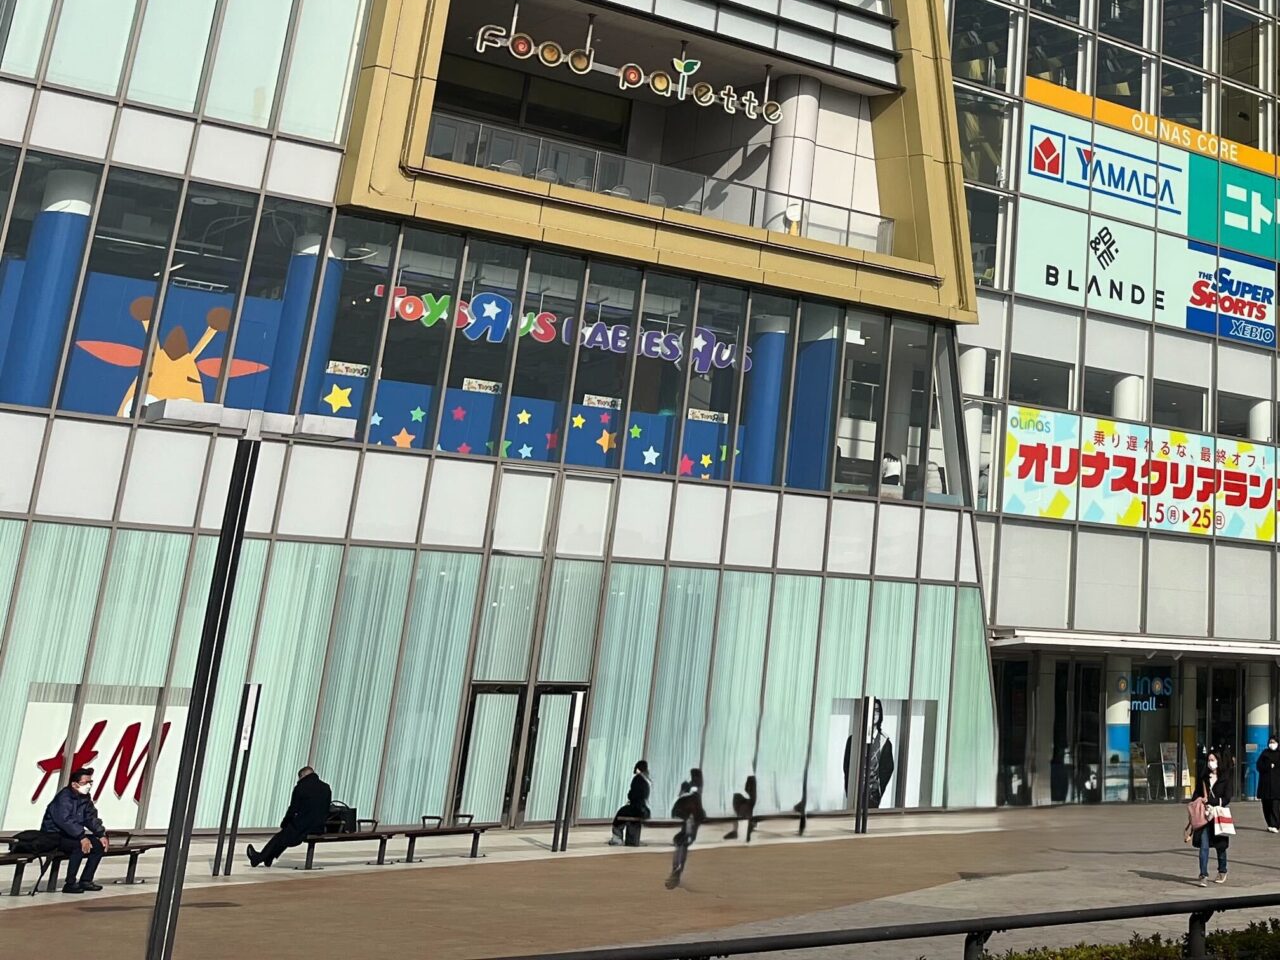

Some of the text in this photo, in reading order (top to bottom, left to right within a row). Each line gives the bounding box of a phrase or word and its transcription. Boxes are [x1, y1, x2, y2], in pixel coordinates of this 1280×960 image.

[1131, 113, 1239, 162] OLINAS CORE
[1076, 146, 1175, 205] YAMADA
[1045, 264, 1165, 310] BLANDE
[1189, 280, 1267, 321] SPORTS
[1198, 267, 1275, 305] THE SUPER
[1229, 319, 1275, 343] XEBIO
[31, 719, 171, 804] HM
